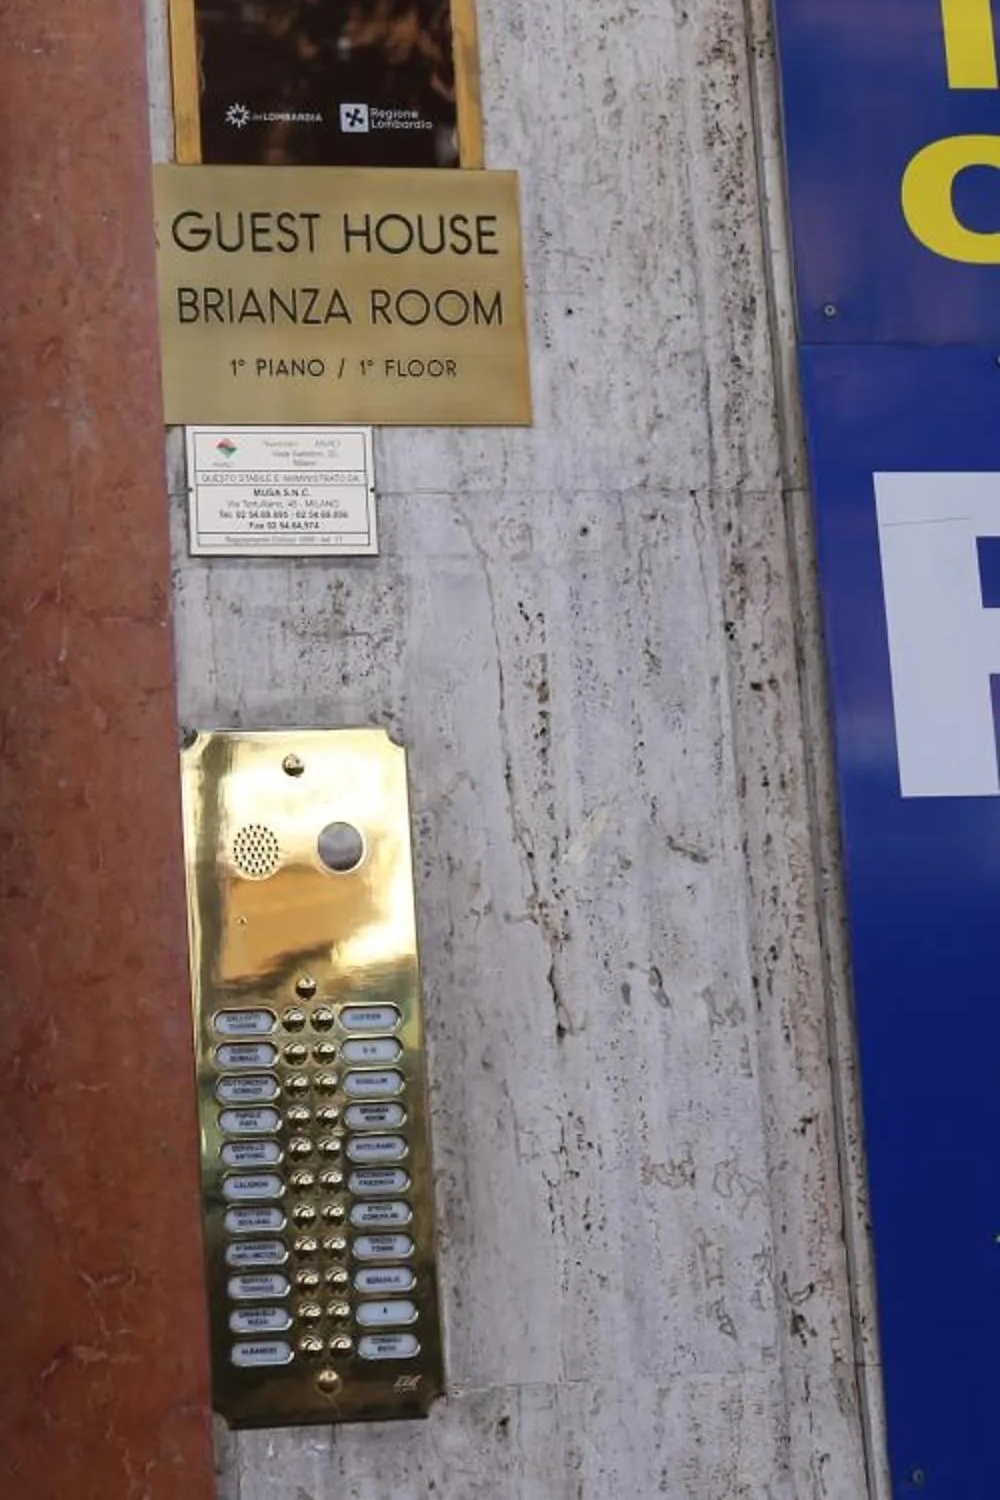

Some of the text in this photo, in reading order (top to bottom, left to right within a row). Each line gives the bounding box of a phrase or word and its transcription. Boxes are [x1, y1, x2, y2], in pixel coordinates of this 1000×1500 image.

[370, 107, 419, 120] Regione
[371, 119, 433, 129] Lombardia
[172, 211, 498, 254] GUEST HOUSE
[177, 287, 503, 326] BRIANZA ROOM
[256, 359, 325, 377] PIANO
[337, 358, 346, 378] /
[385, 360, 457, 377] FLOOR
